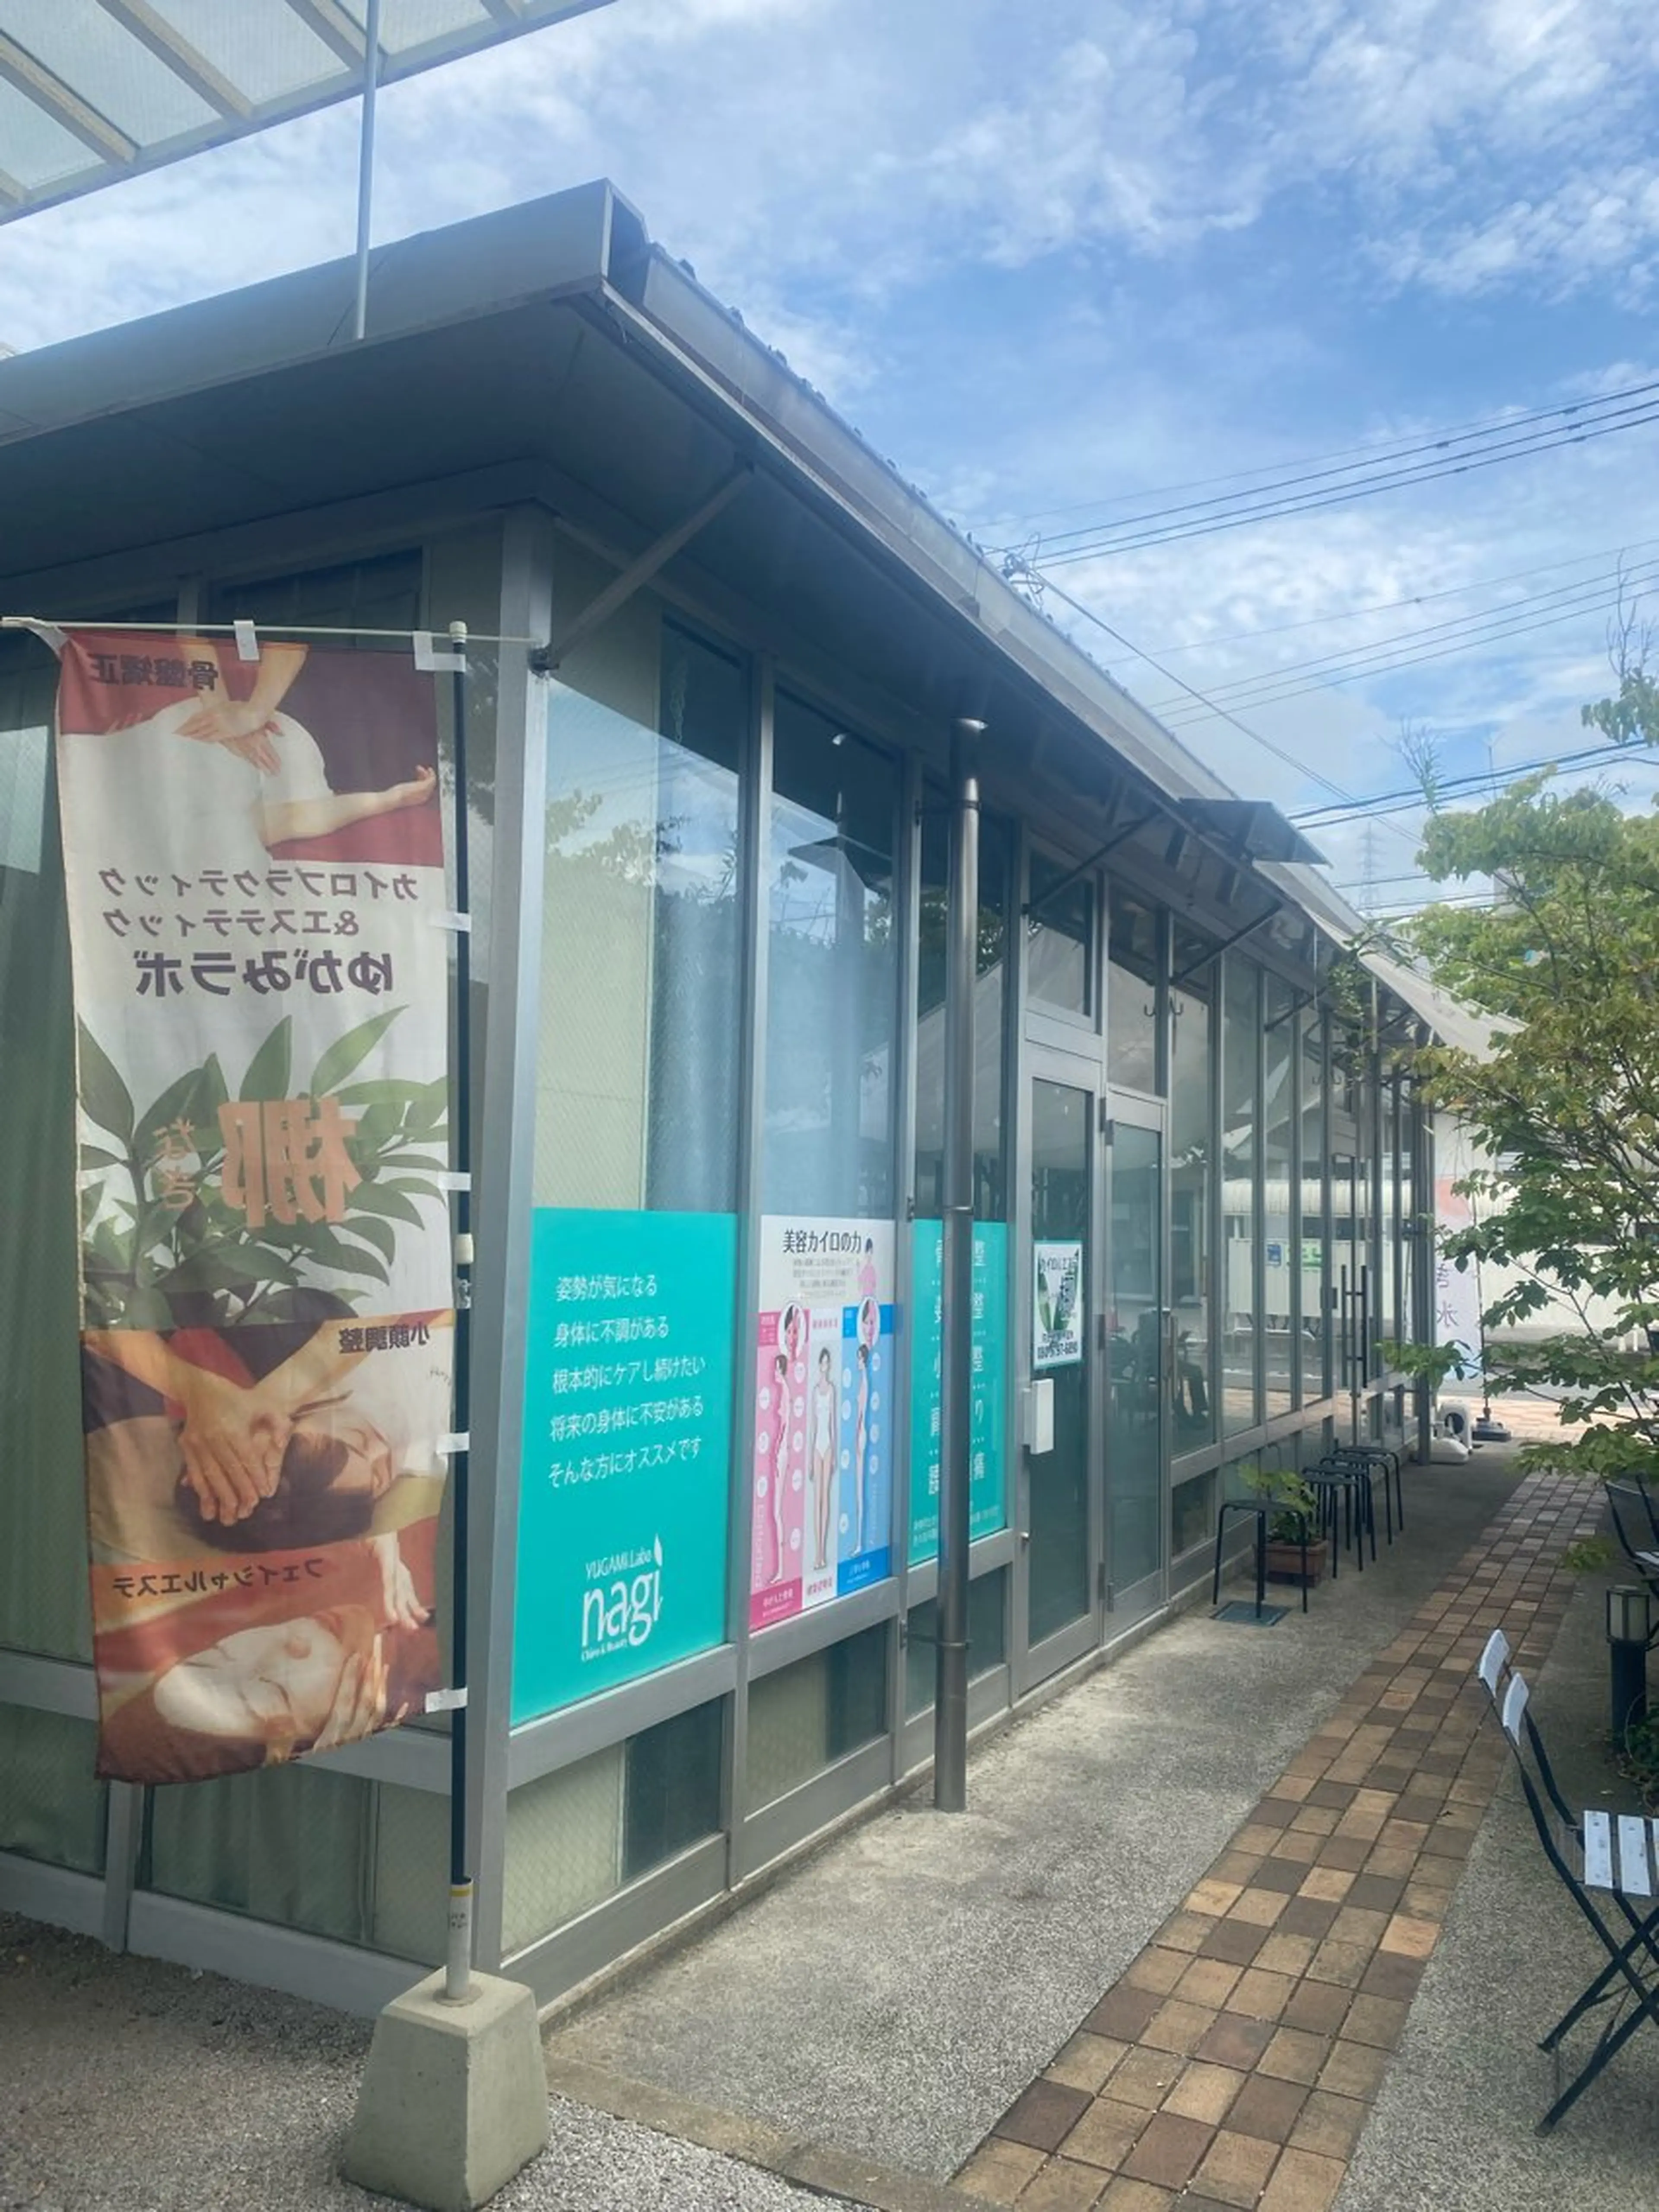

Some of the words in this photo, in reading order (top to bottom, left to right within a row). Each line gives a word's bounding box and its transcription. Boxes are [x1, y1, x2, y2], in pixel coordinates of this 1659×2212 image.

[782, 1228, 861, 1253] 美容カイロの力
[555, 1274, 658, 1302] 姿勢が気になる
[553, 1316, 669, 1348] 身体に不調がある
[552, 1355, 706, 1395] 根本的にケアし続けたい
[549, 1395, 704, 1442] 将来の身体に不安がある
[548, 1437, 702, 1488] そんな方にオススメです
[582, 1534, 664, 1646] nagi
